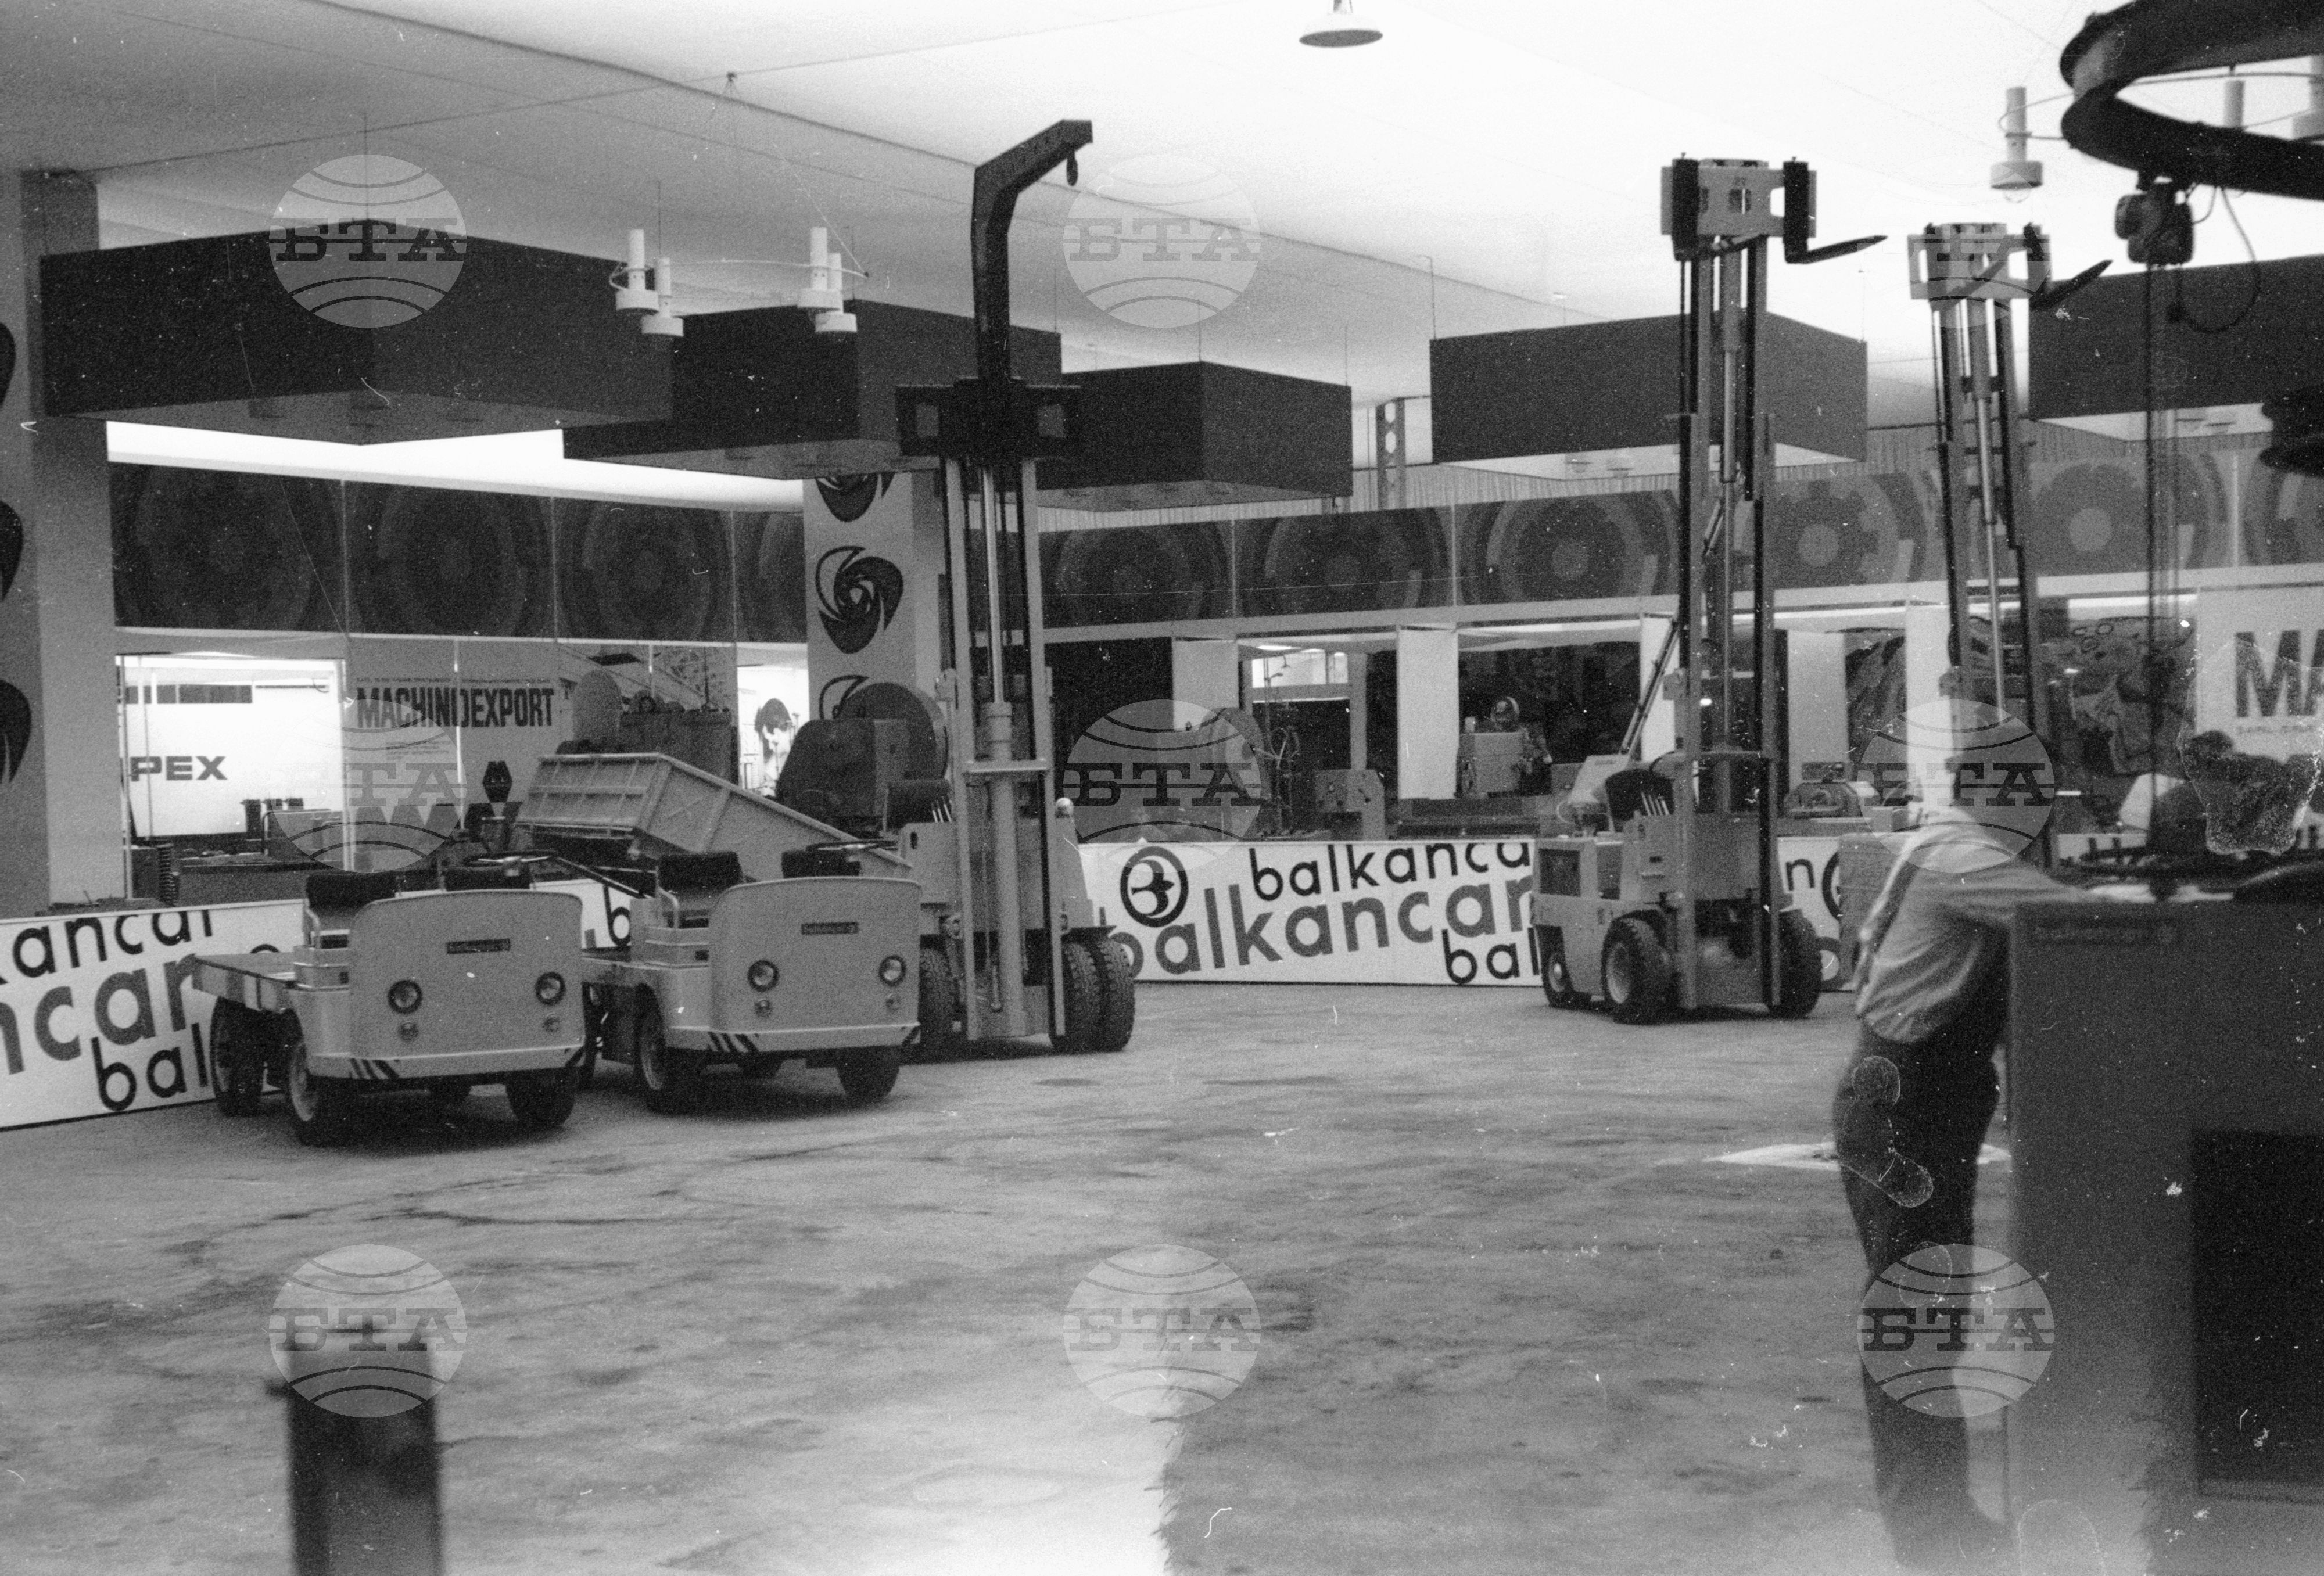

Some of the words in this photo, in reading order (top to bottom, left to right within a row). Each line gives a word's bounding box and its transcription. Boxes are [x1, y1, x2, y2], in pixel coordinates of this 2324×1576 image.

[130, 756, 228, 782] PEX
[0, 909, 213, 985] anca
[1441, 927, 1540, 985] bal
[91, 1022, 209, 1112] bal
